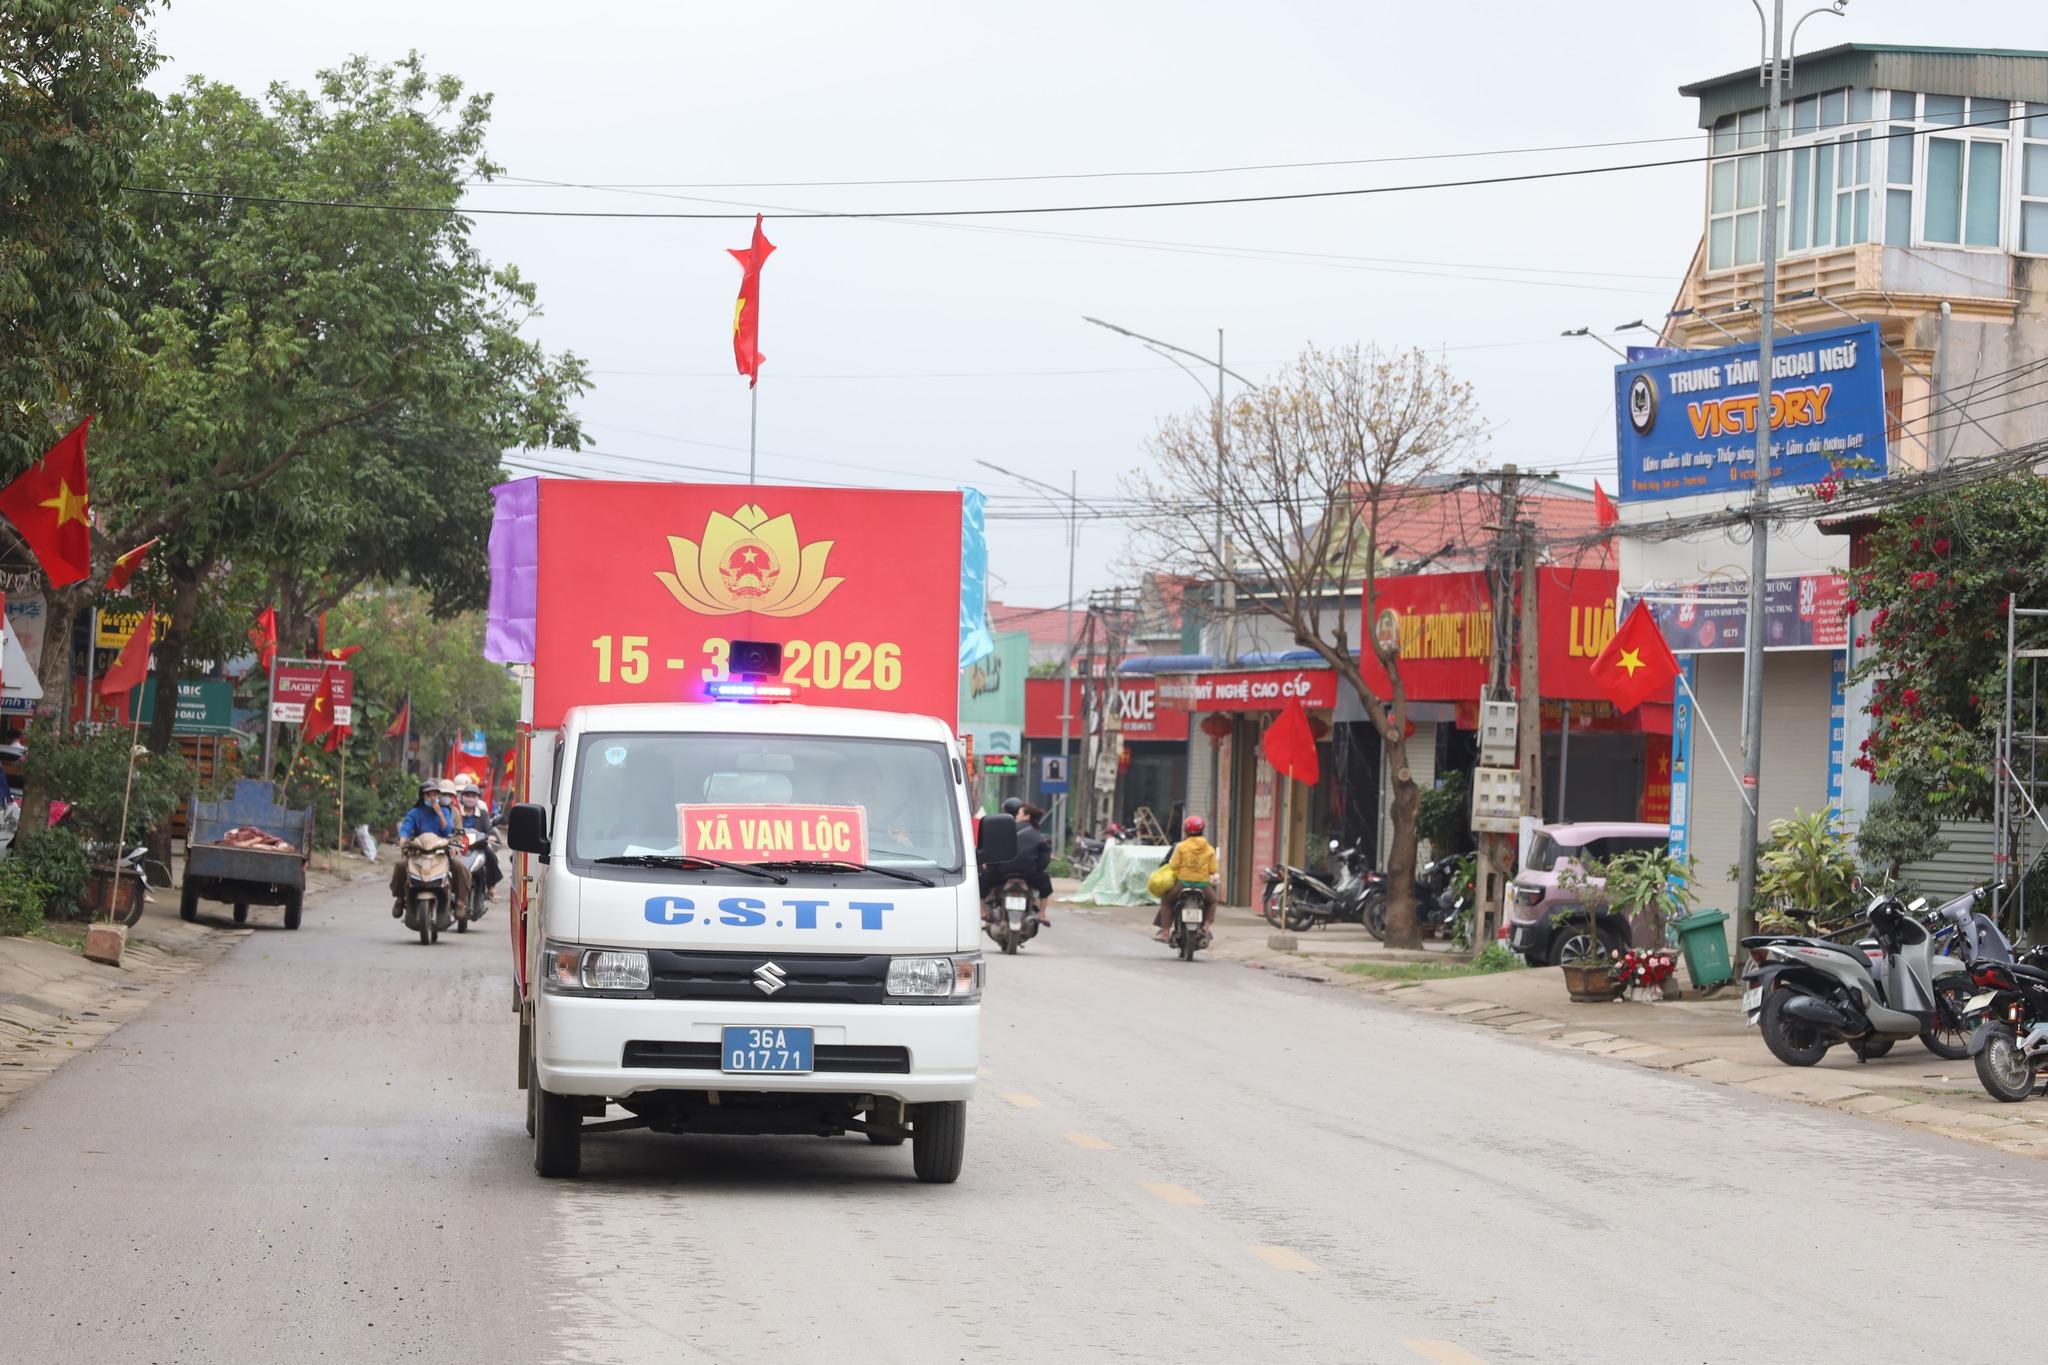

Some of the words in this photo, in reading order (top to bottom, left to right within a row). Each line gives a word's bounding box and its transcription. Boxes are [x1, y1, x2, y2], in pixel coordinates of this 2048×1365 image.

[1669, 366, 1721, 394] TRUNG
[1724, 358, 1759, 386] TÂM
[1819, 340, 1857, 372] NGỮ
[1687, 383, 1832, 439] VICTORY
[1770, 442, 1780, 459] uệ
[1424, 604, 1463, 659] PHÒNG
[591, 635, 649, 684] 15
[783, 640, 902, 690] 2026
[1216, 680, 1249, 702] NGHỆ
[1251, 681, 1279, 698] CAO
[697, 814, 733, 851] XÃ
[740, 819, 794, 857] VẠN
[801, 815, 851, 858] LỘC
[644, 896, 895, 930] C.S.T.T
[748, 1030, 787, 1049] 36A
[732, 1050, 801, 1070] 017.71
